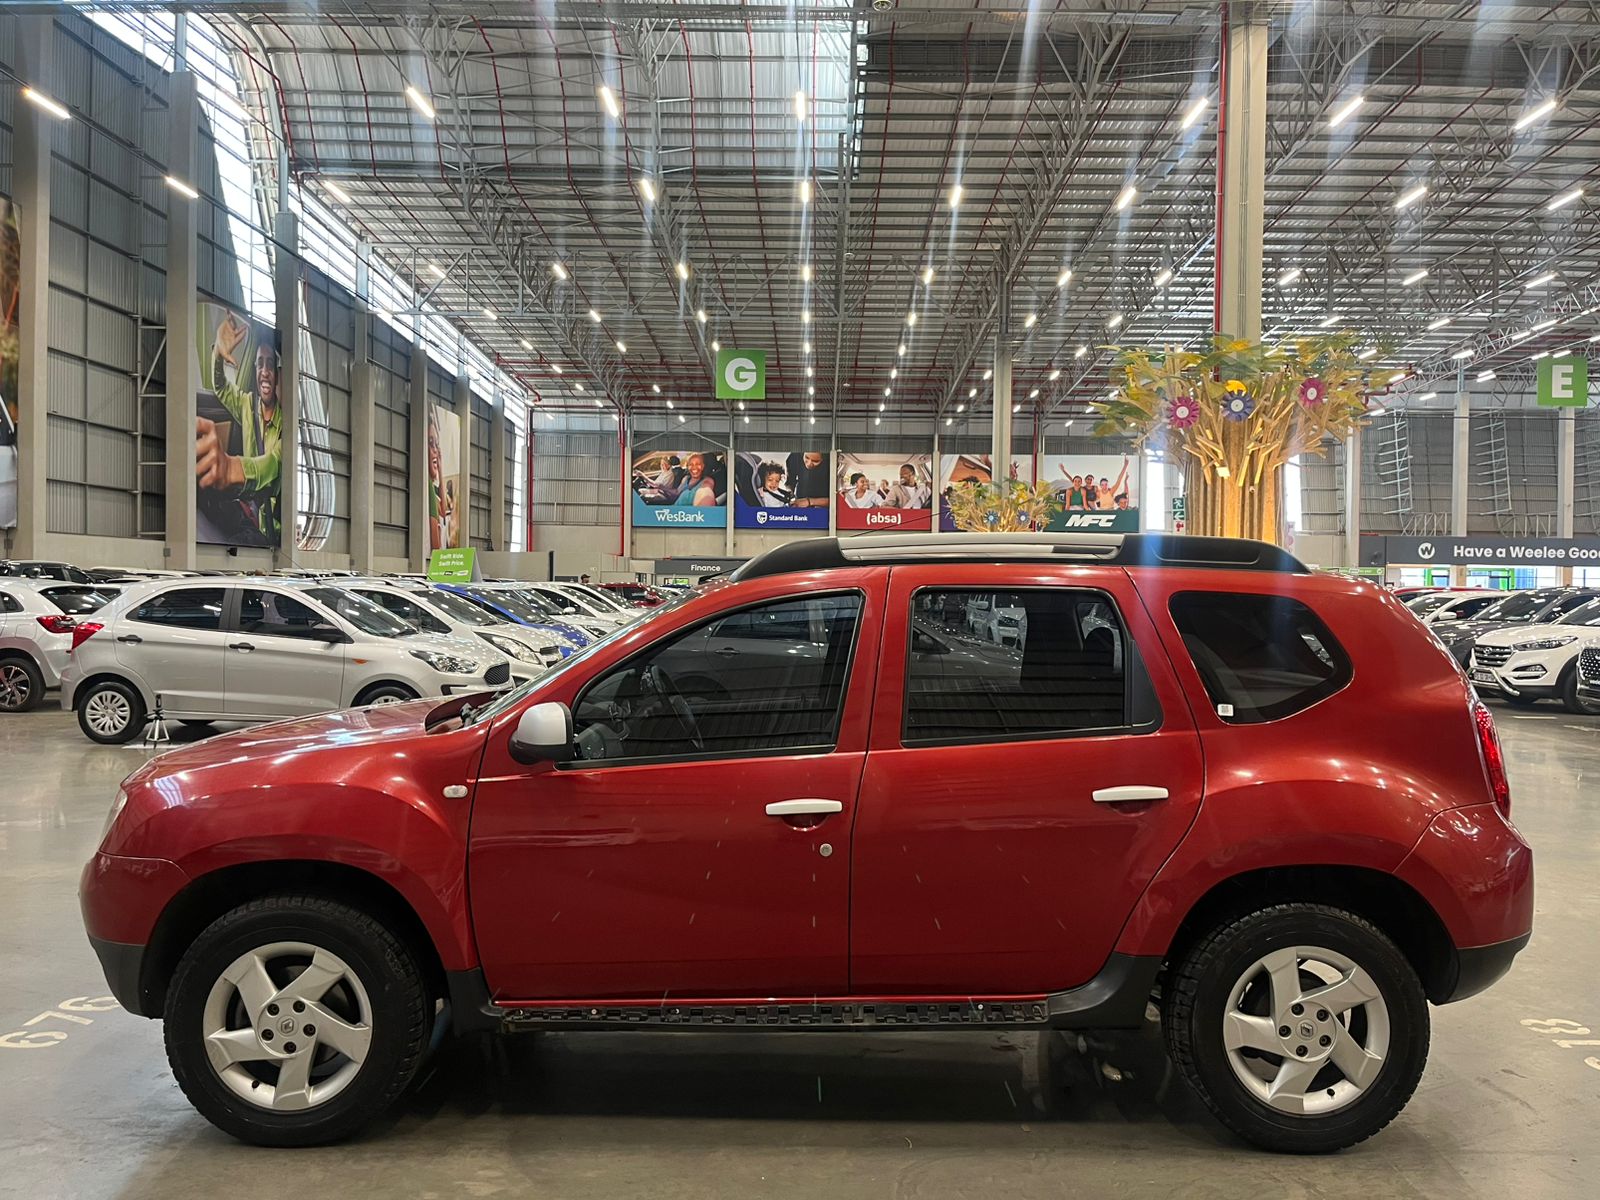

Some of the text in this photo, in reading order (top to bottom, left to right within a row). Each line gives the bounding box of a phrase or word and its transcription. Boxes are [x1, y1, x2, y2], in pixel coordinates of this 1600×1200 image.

[725, 357, 757, 391] G
[1551, 364, 1574, 399] E
[655, 508, 705, 522] WesBank
[769, 514, 808, 522] Standard Bank
[866, 512, 902, 525] (absa)
[1065, 514, 1116, 528] MFC
[1453, 545, 1493, 558] Have
[1496, 547, 1505, 558] a
[1509, 545, 1565, 559] Weelee
[1568, 546, 1600, 559] Goo
[690, 564, 721, 572] Finance
